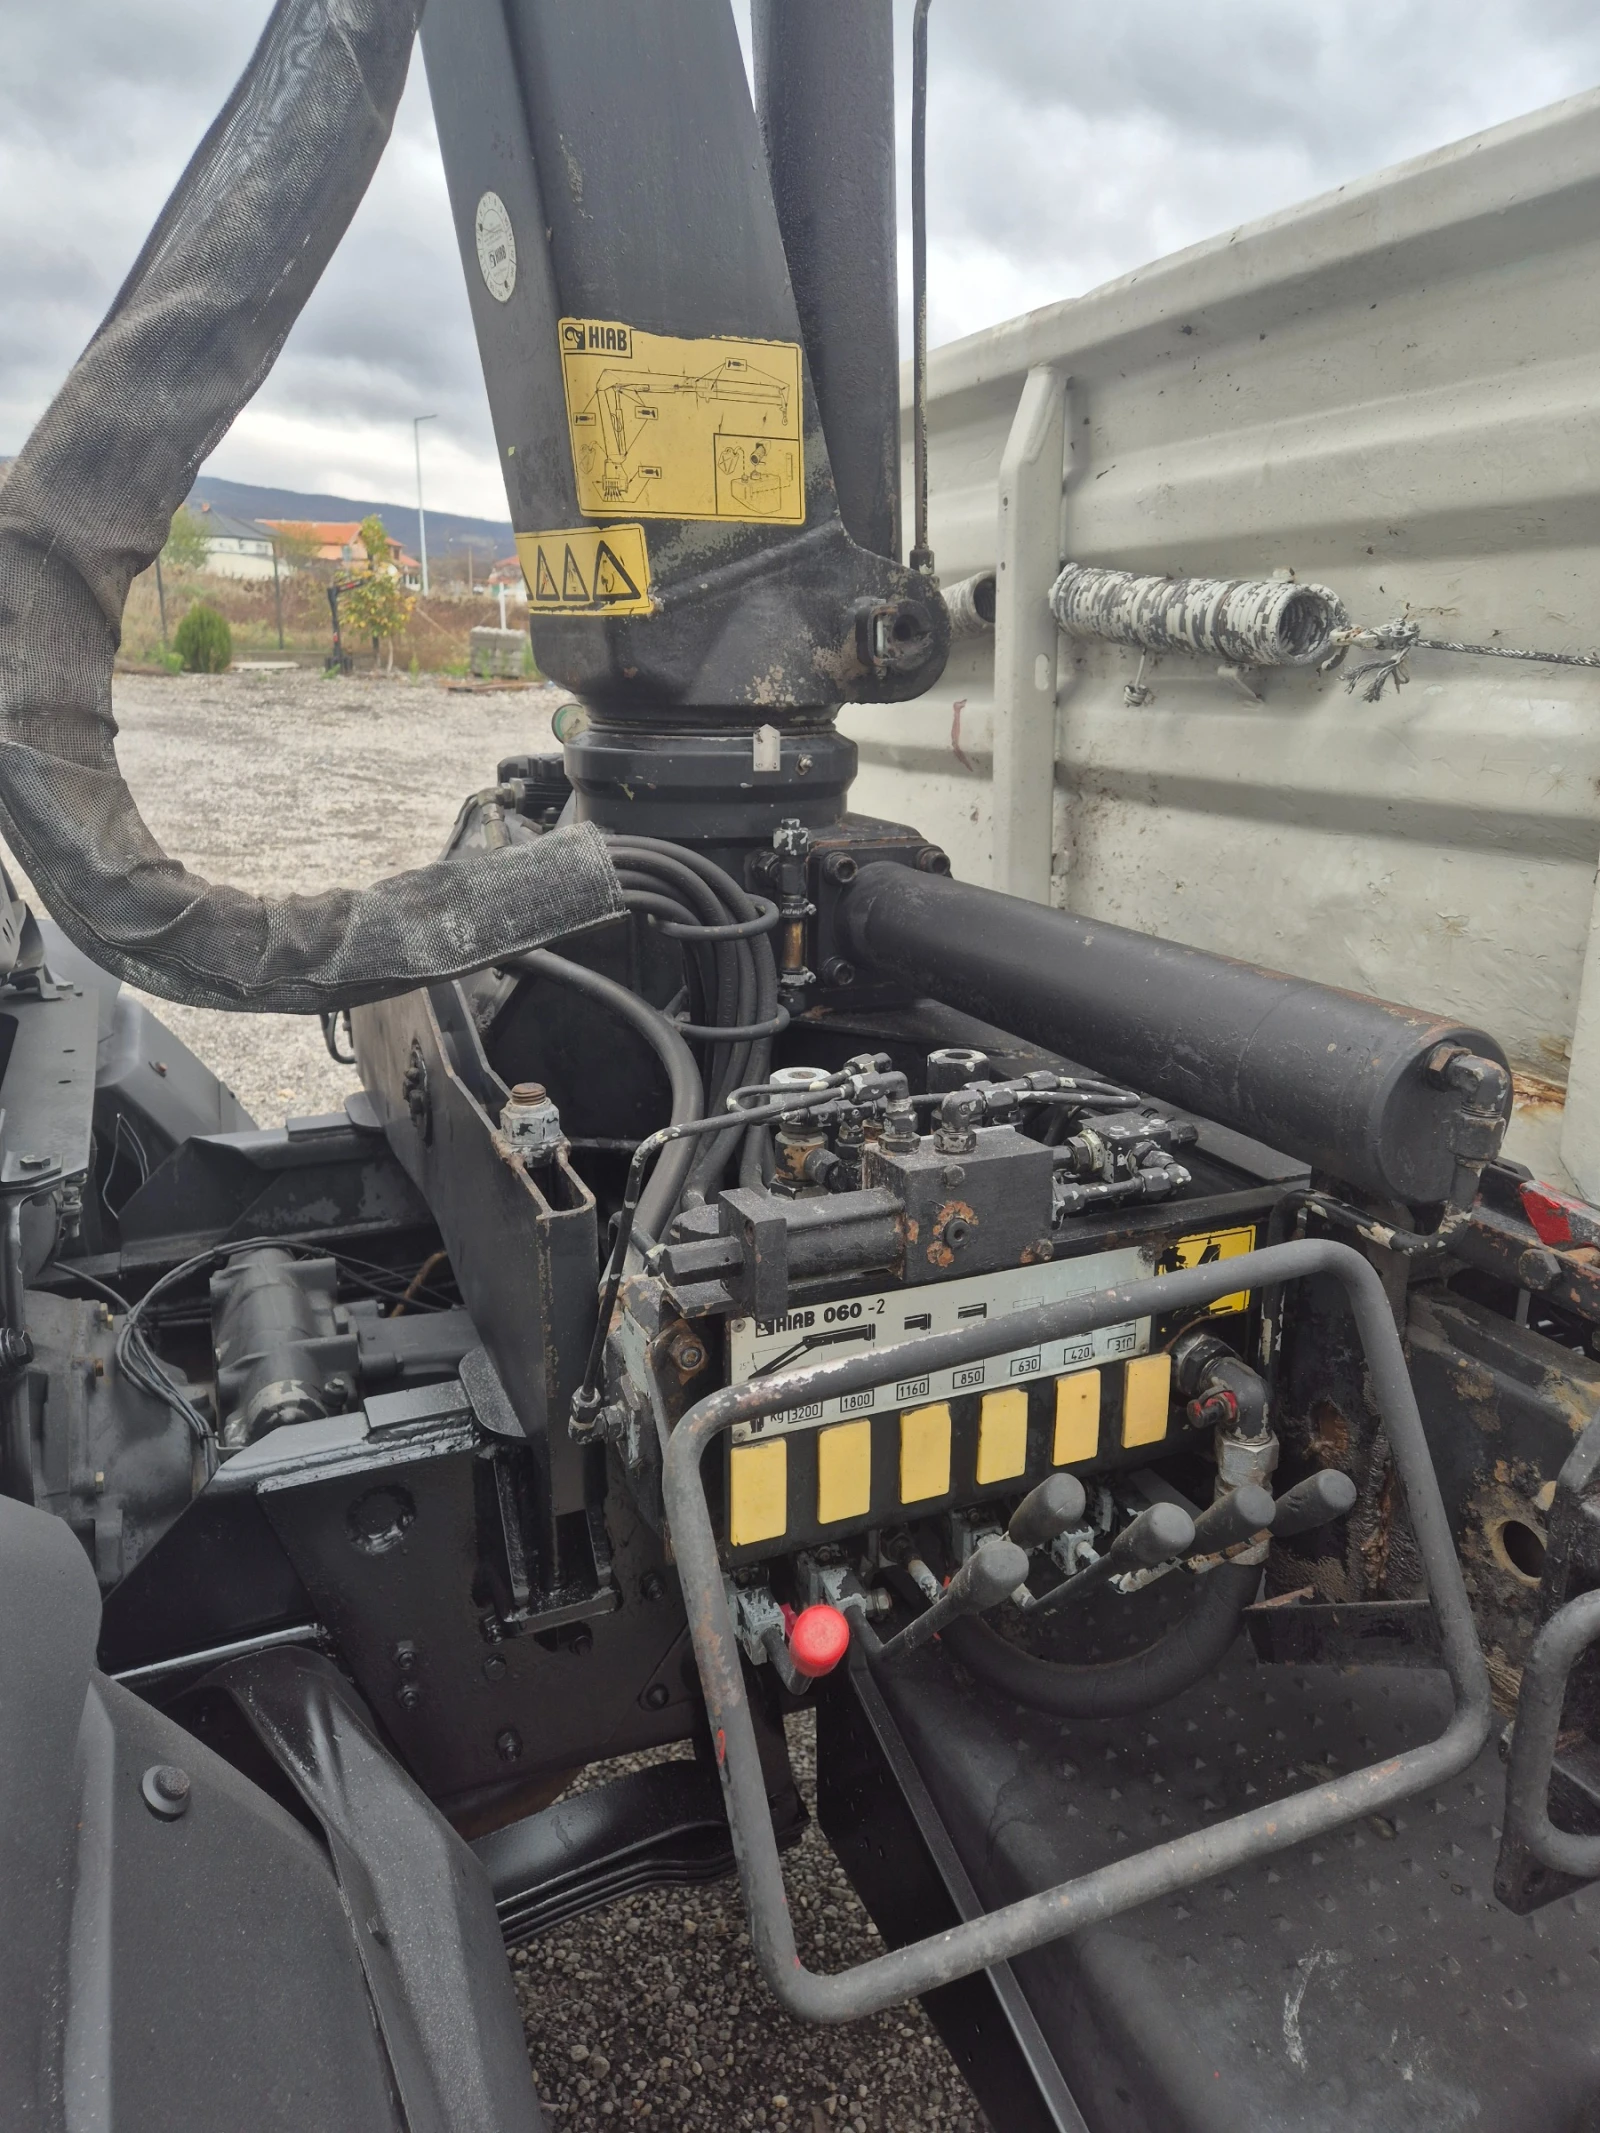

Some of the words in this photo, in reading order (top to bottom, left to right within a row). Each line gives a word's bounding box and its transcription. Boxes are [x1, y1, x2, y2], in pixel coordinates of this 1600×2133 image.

[588, 325, 628, 351] HIAB
[775, 1310, 815, 1333] HIAB
[823, 1302, 862, 1323] 060
[791, 1404, 819, 1420] 3200
[843, 1393, 870, 1409] 1800
[900, 1382, 926, 1398] 1160
[960, 1370, 981, 1385] 850
[1018, 1359, 1038, 1373] 630
[1071, 1347, 1090, 1360] 420
